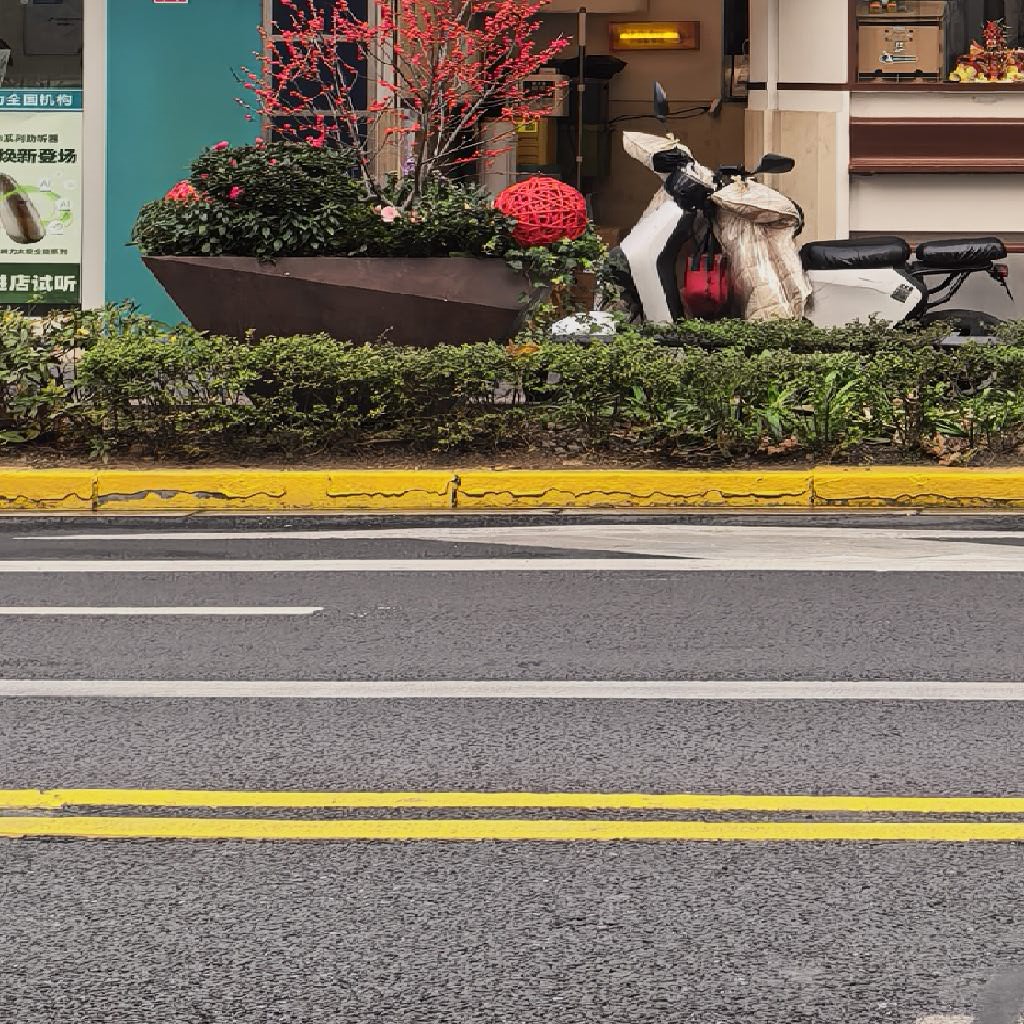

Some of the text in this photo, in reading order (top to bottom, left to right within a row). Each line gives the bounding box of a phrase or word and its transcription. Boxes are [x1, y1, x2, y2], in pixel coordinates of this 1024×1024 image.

[0, 134, 59, 143] 系列助听器
